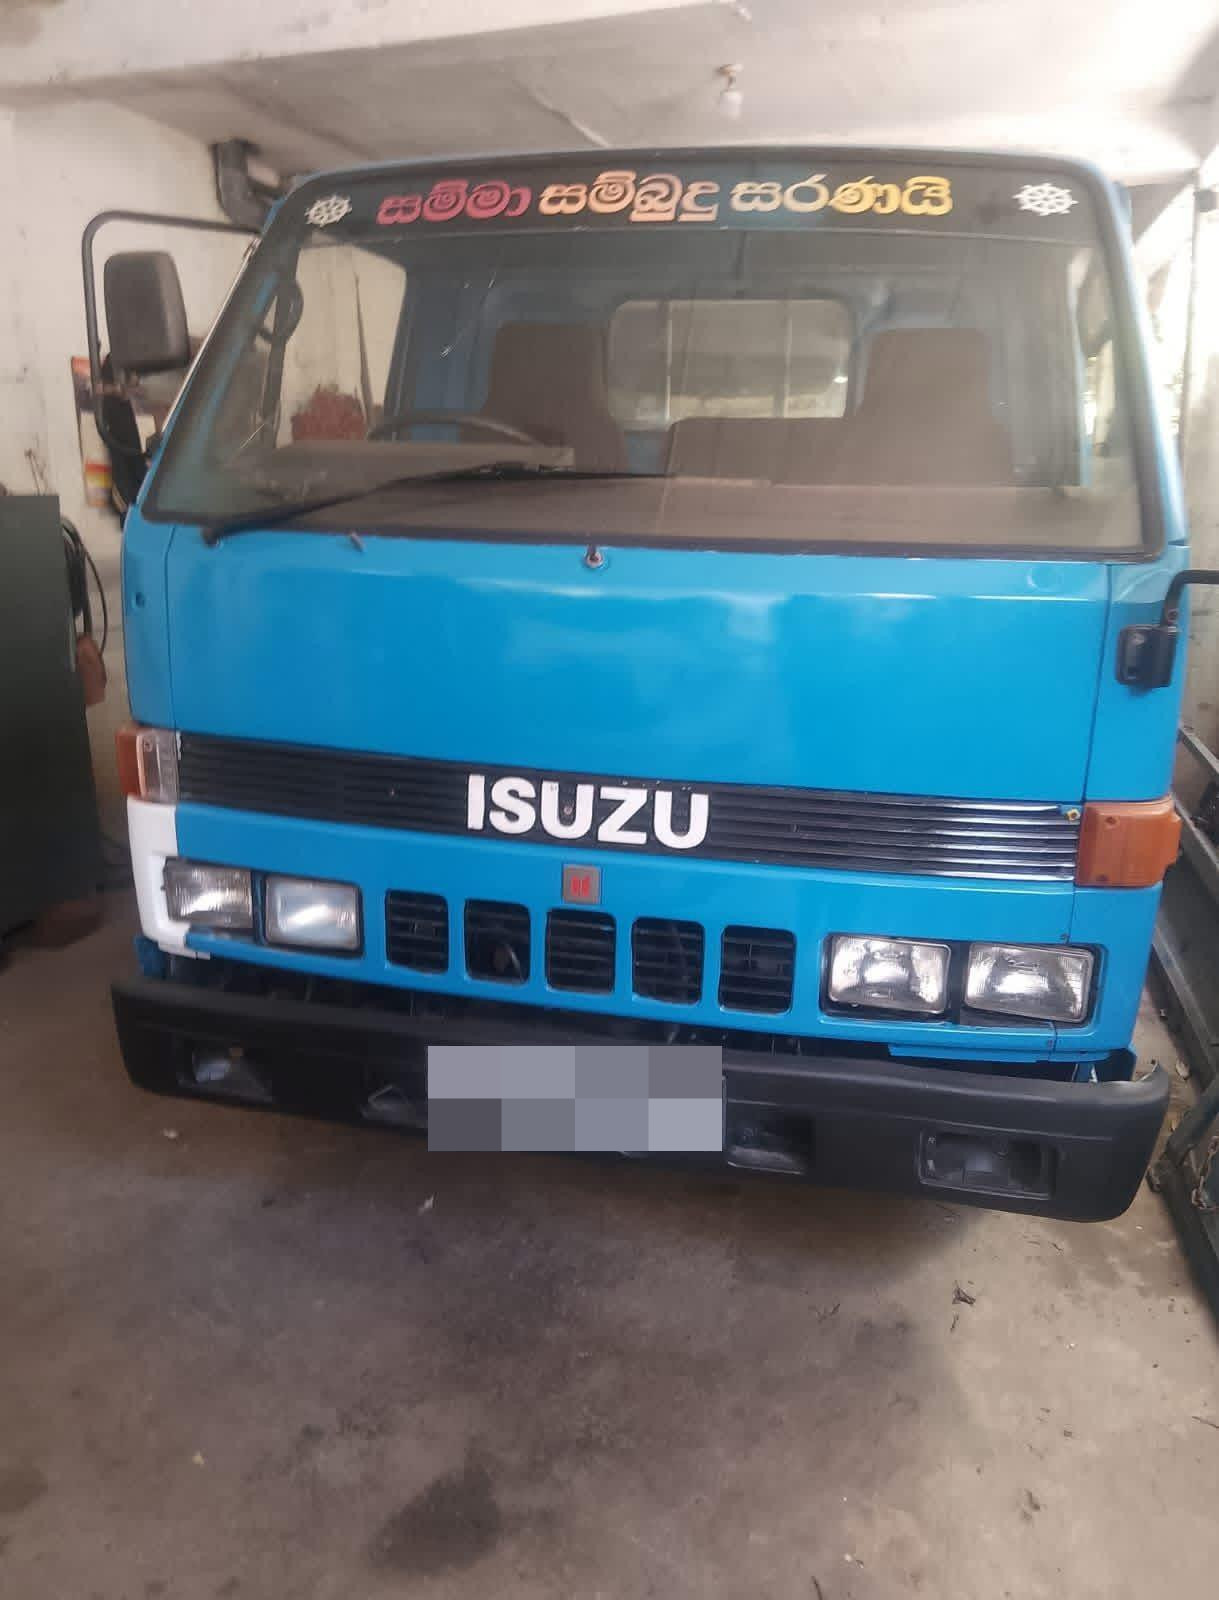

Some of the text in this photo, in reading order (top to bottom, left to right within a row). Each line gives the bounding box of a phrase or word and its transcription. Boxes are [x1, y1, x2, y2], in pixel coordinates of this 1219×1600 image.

[376, 170, 953, 224] සම්මා සම්බුදු සරණයි
[467, 774, 709, 849] ISUZU
